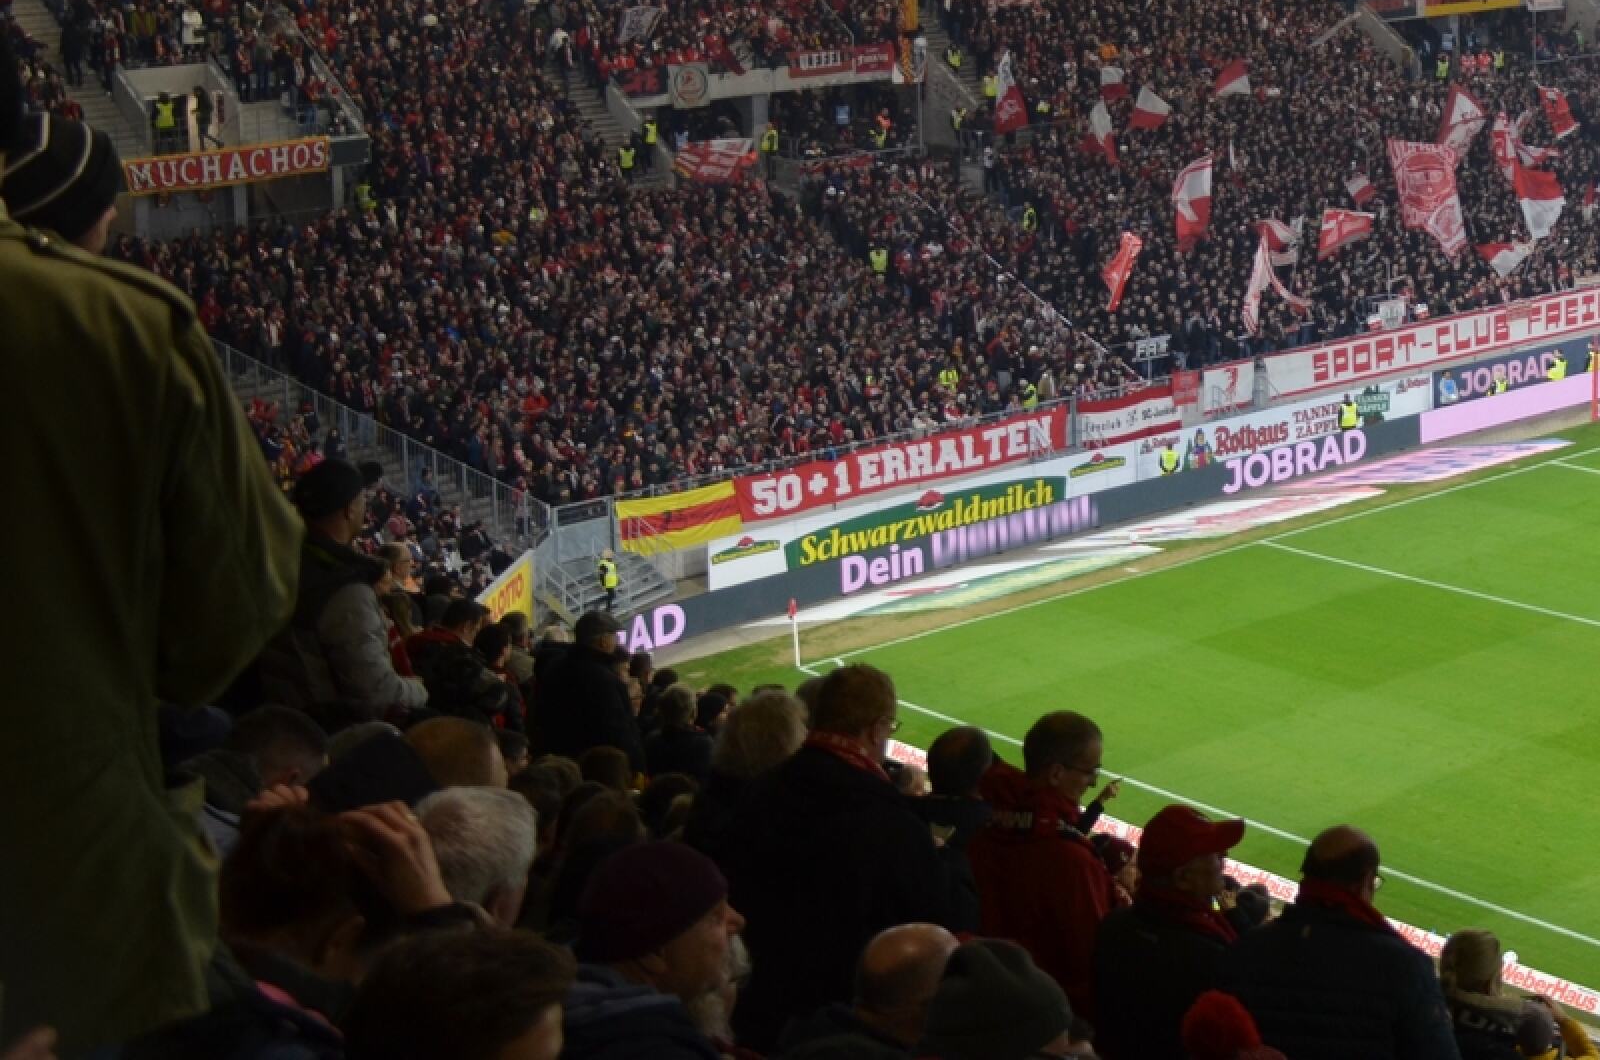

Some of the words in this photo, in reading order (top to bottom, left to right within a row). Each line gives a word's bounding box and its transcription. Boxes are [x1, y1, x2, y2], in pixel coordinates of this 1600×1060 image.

[128, 141, 326, 190] MUCHACHOS
[1313, 314, 1510, 382] SPORT-CLUB
[1293, 403, 1339, 423] TANNE
[857, 415, 1054, 489] ERHALTEN
[1214, 421, 1289, 457] Rothaus
[1222, 429, 1367, 494] JOBRAD
[800, 478, 1053, 566] Schwarzwaldmilch
[841, 542, 925, 593] Dein
[1502, 963, 1598, 1011] WeberHaus
